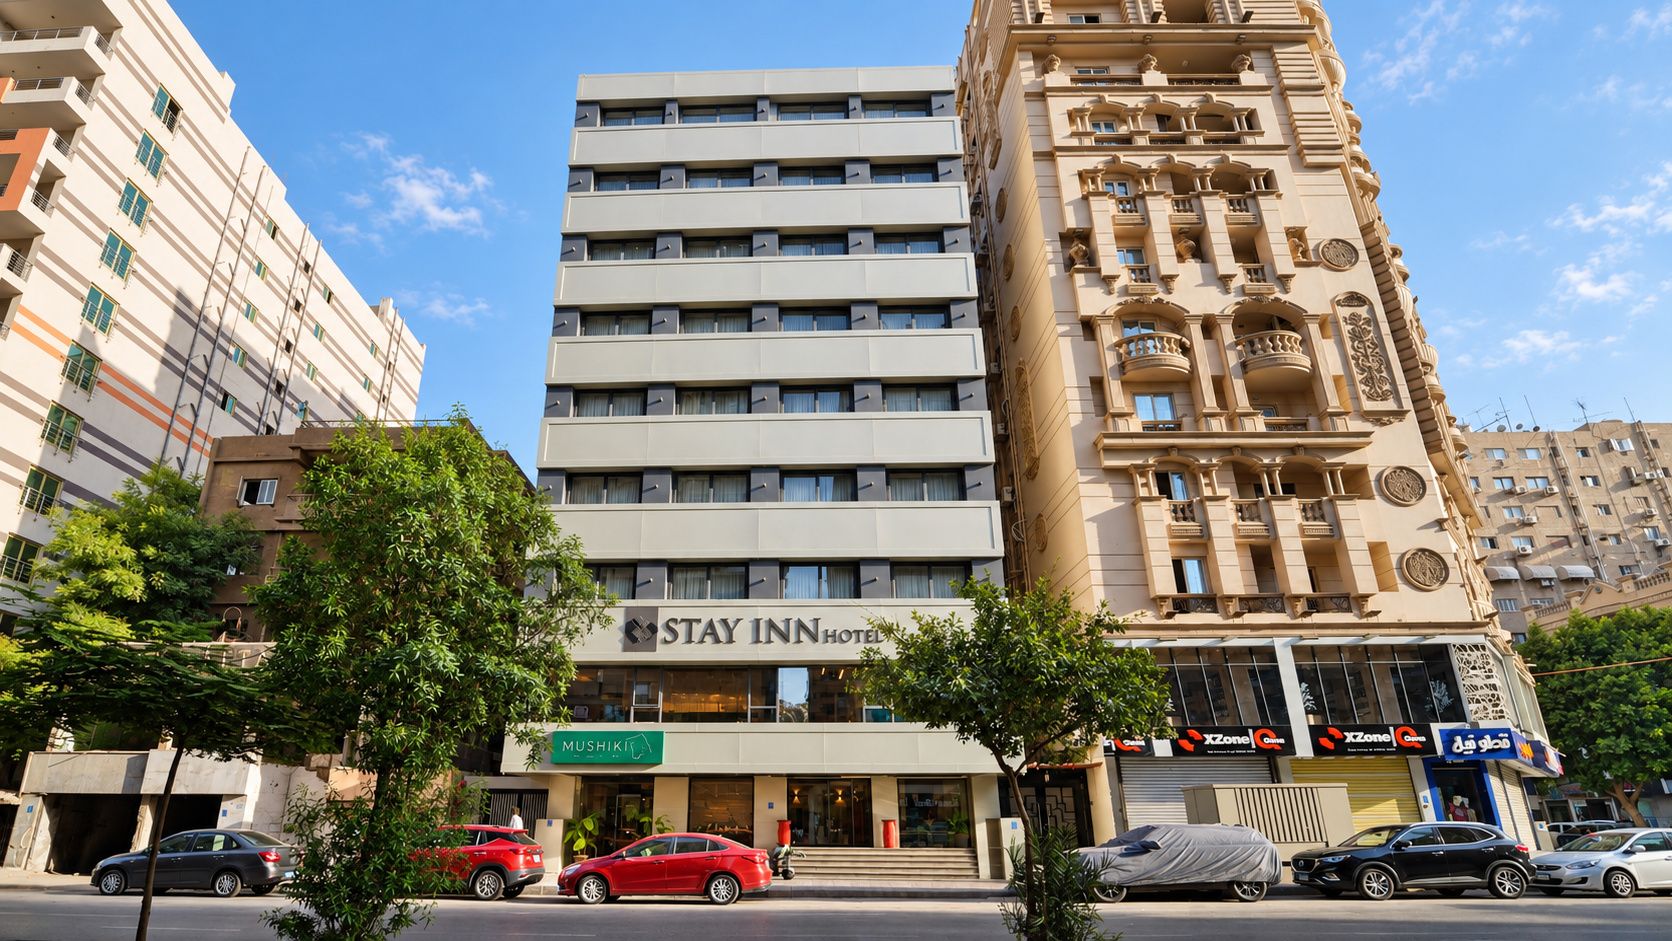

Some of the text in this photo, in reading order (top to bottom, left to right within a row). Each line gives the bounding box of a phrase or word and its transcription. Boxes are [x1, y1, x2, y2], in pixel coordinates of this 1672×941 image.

[662, 617, 884, 645] STAY INN HOTEL
[1203, 733, 1249, 746] XZone
[1343, 731, 1391, 743] XZone
[562, 740, 628, 752] MUSHIKI
